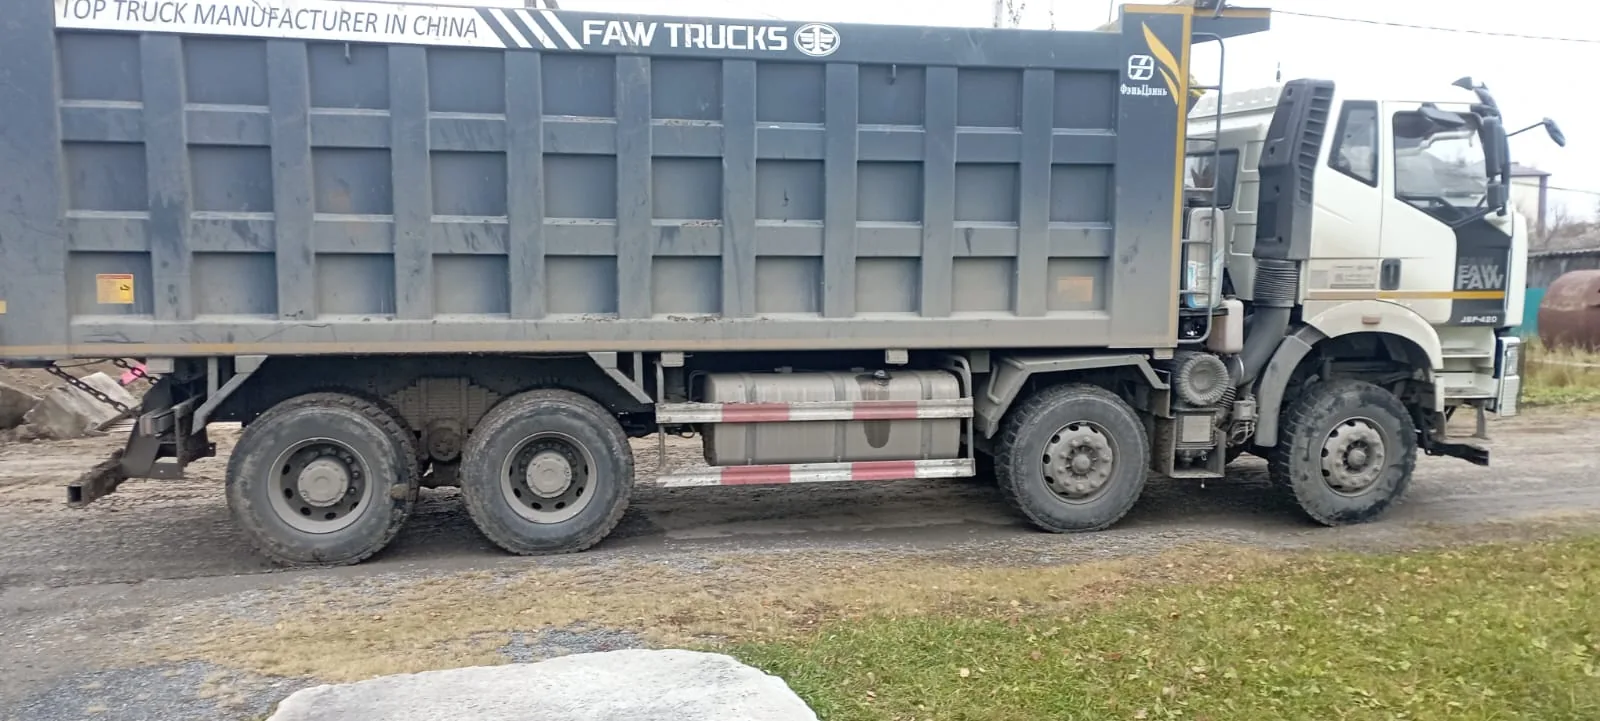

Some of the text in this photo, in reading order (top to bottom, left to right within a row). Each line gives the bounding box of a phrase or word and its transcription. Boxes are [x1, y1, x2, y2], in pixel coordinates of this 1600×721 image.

[62, 0, 478, 39] TOP TRUCK MANUFACTURER IN CHINA
[582, 20, 788, 51] FAW TRUCKS
[1455, 273, 1504, 290] FAW
